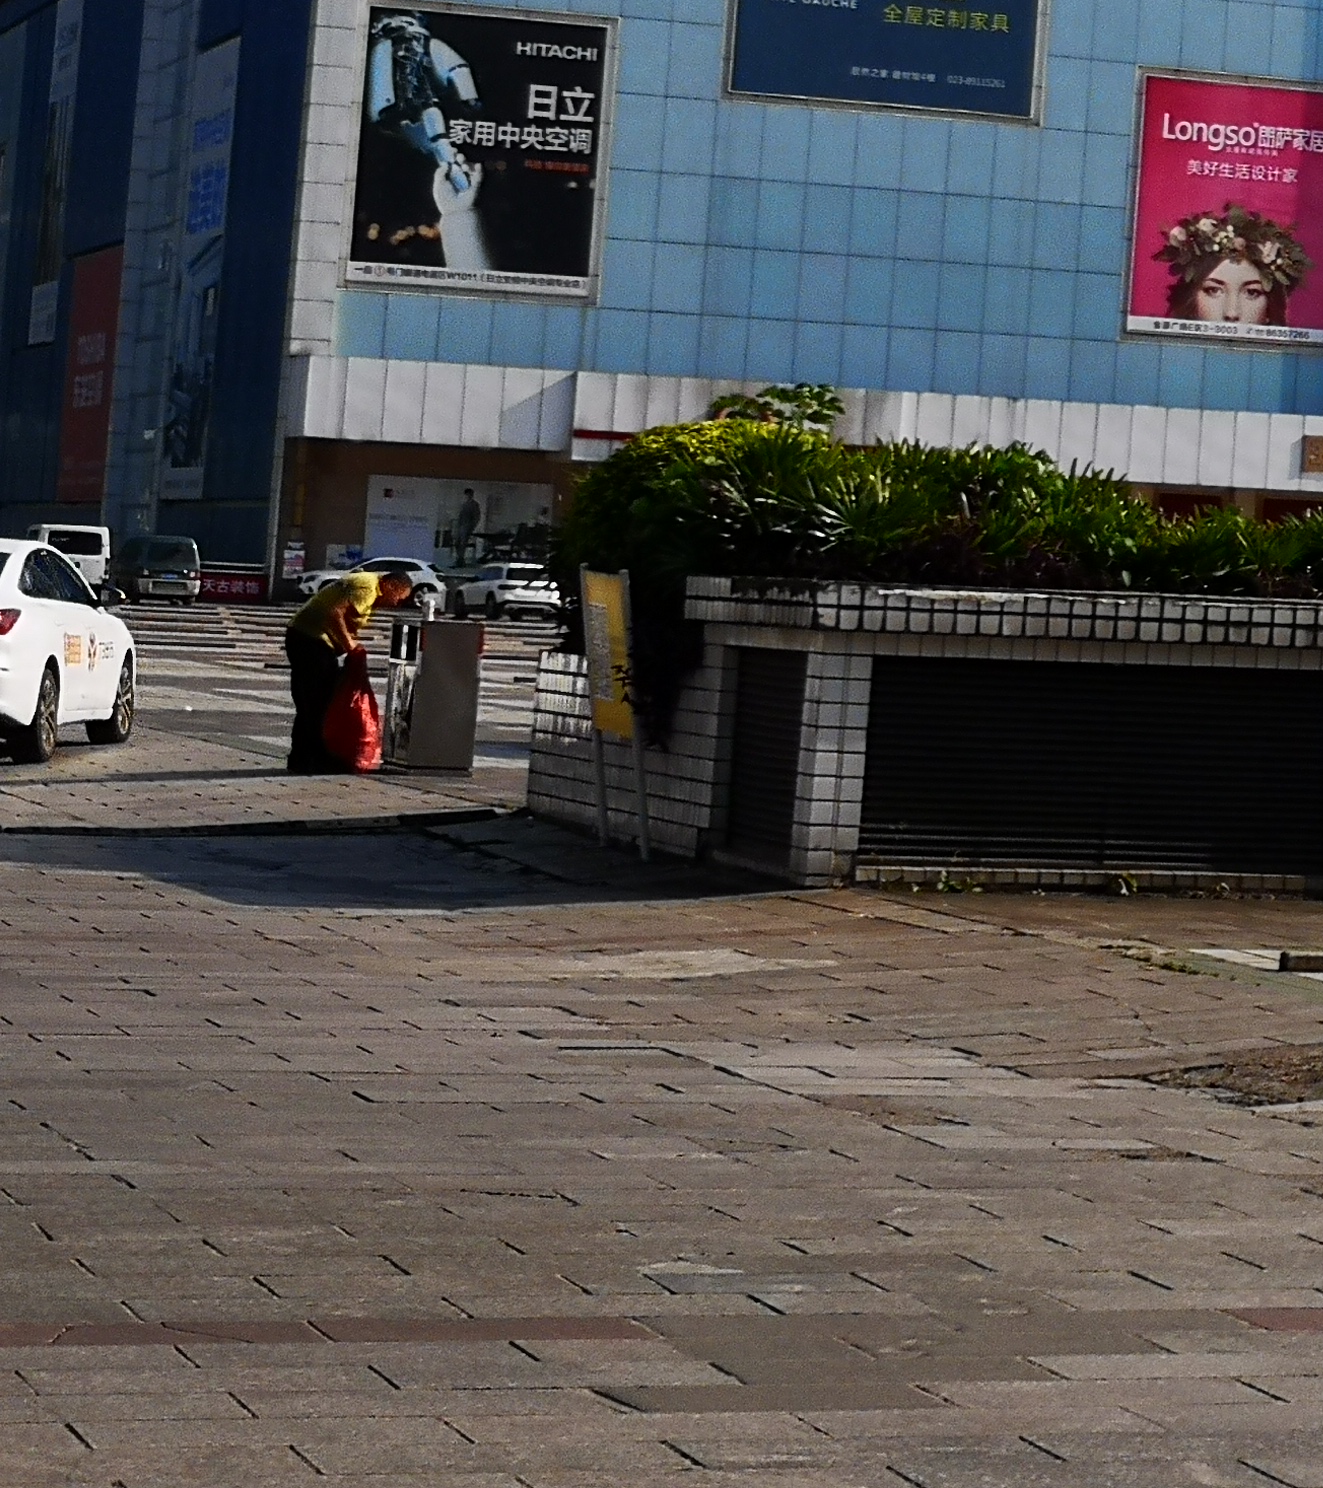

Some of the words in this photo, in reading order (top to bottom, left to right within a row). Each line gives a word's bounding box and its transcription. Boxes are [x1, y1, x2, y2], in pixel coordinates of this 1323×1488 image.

[883, 3, 1011, 33] 全屋定制家具
[515, 41, 598, 62] HITACHI
[527, 83, 595, 123] 日立
[449, 118, 593, 155] 家用中央空调
[1162, 112, 1257, 152] Longso
[1186, 159, 1299, 184] 美好生活设计家
